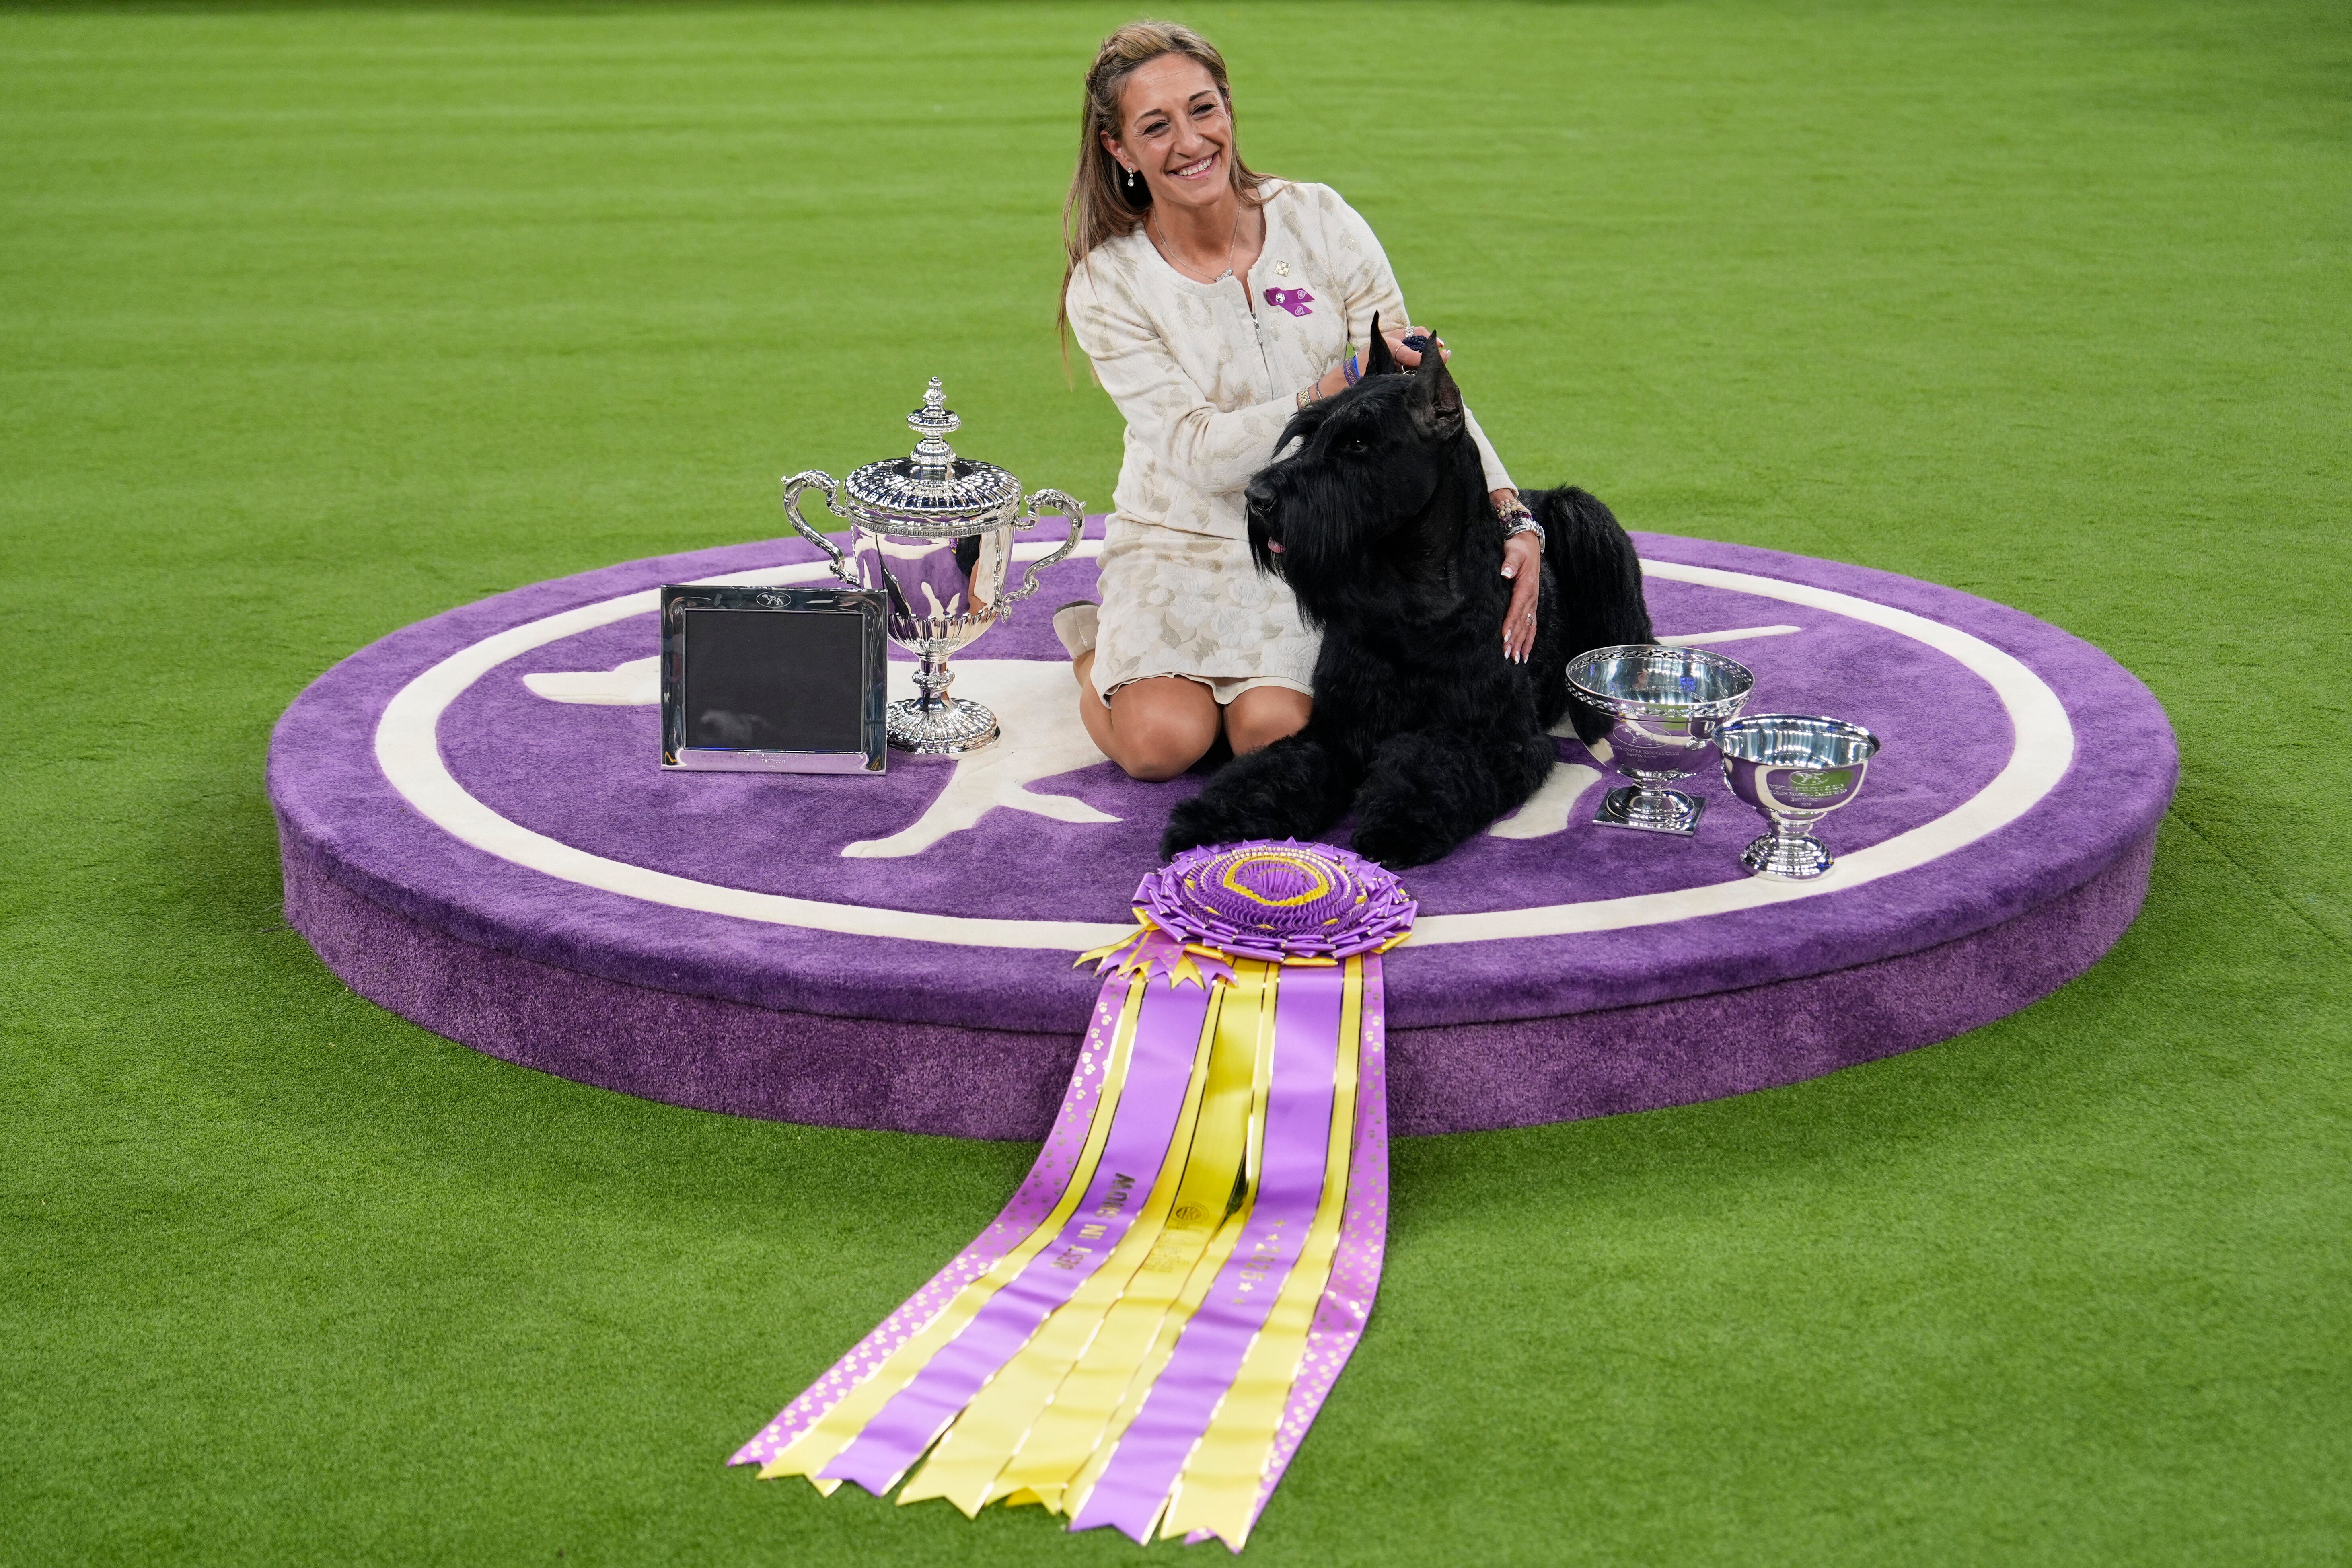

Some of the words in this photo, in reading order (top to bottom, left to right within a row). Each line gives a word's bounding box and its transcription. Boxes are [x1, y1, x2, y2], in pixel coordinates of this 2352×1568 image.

[1346, 364, 1355, 386] TUESDA
[1050, 1244, 1093, 1270] BEST
[1078, 1224, 1107, 1240] IN
[1095, 1173, 1136, 1218] SHOW
[1240, 1243, 1281, 1282] 2025
